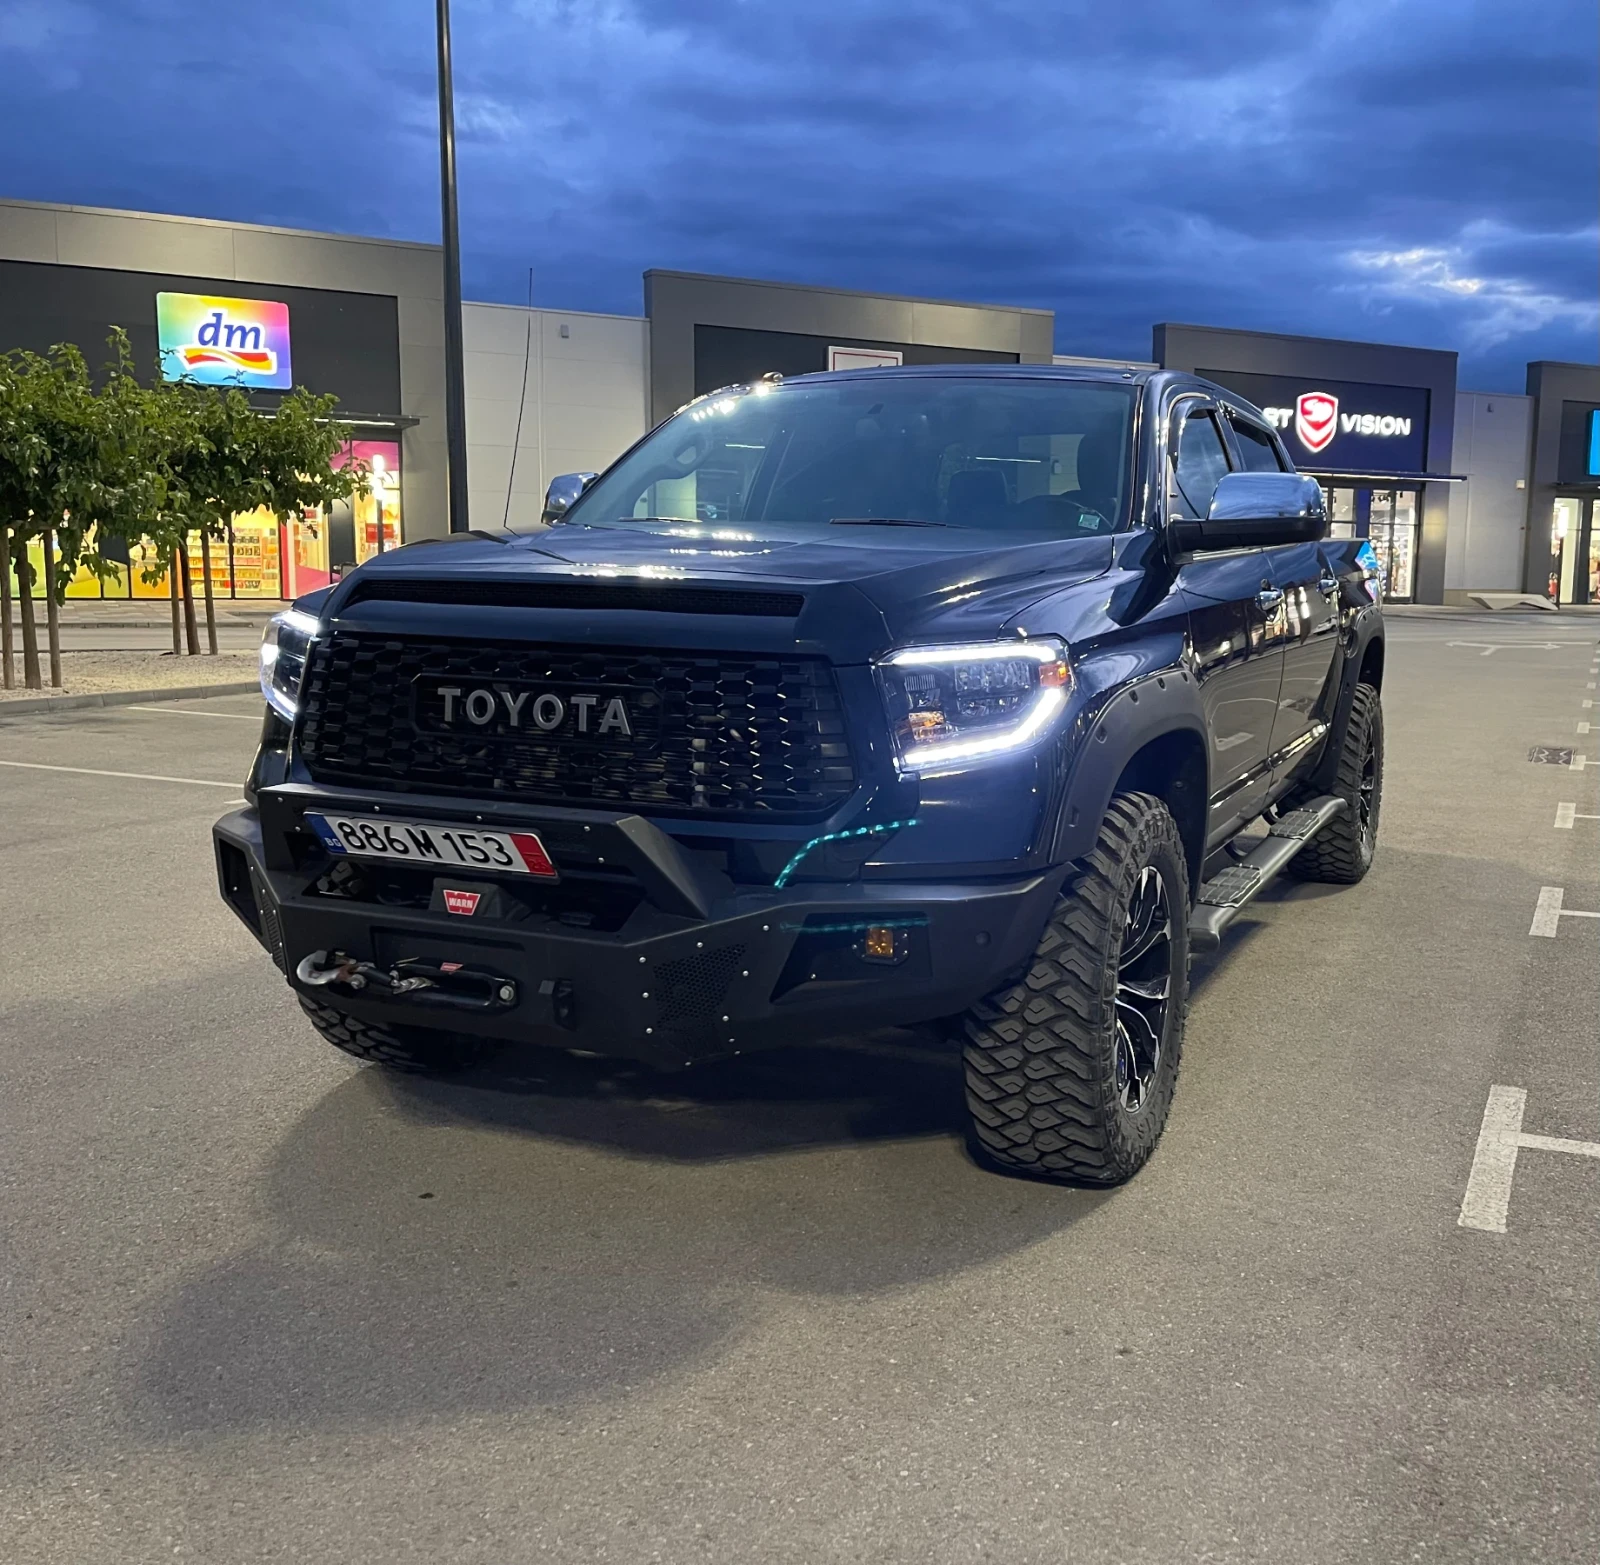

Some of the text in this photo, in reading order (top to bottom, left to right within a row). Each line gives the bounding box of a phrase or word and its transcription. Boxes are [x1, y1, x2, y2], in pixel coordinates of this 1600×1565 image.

[198, 313, 261, 349] dm
[1340, 413, 1411, 436] VISION
[437, 687, 632, 736] TOYOTA
[324, 837, 342, 847] BG
[448, 897, 474, 909] WARN
